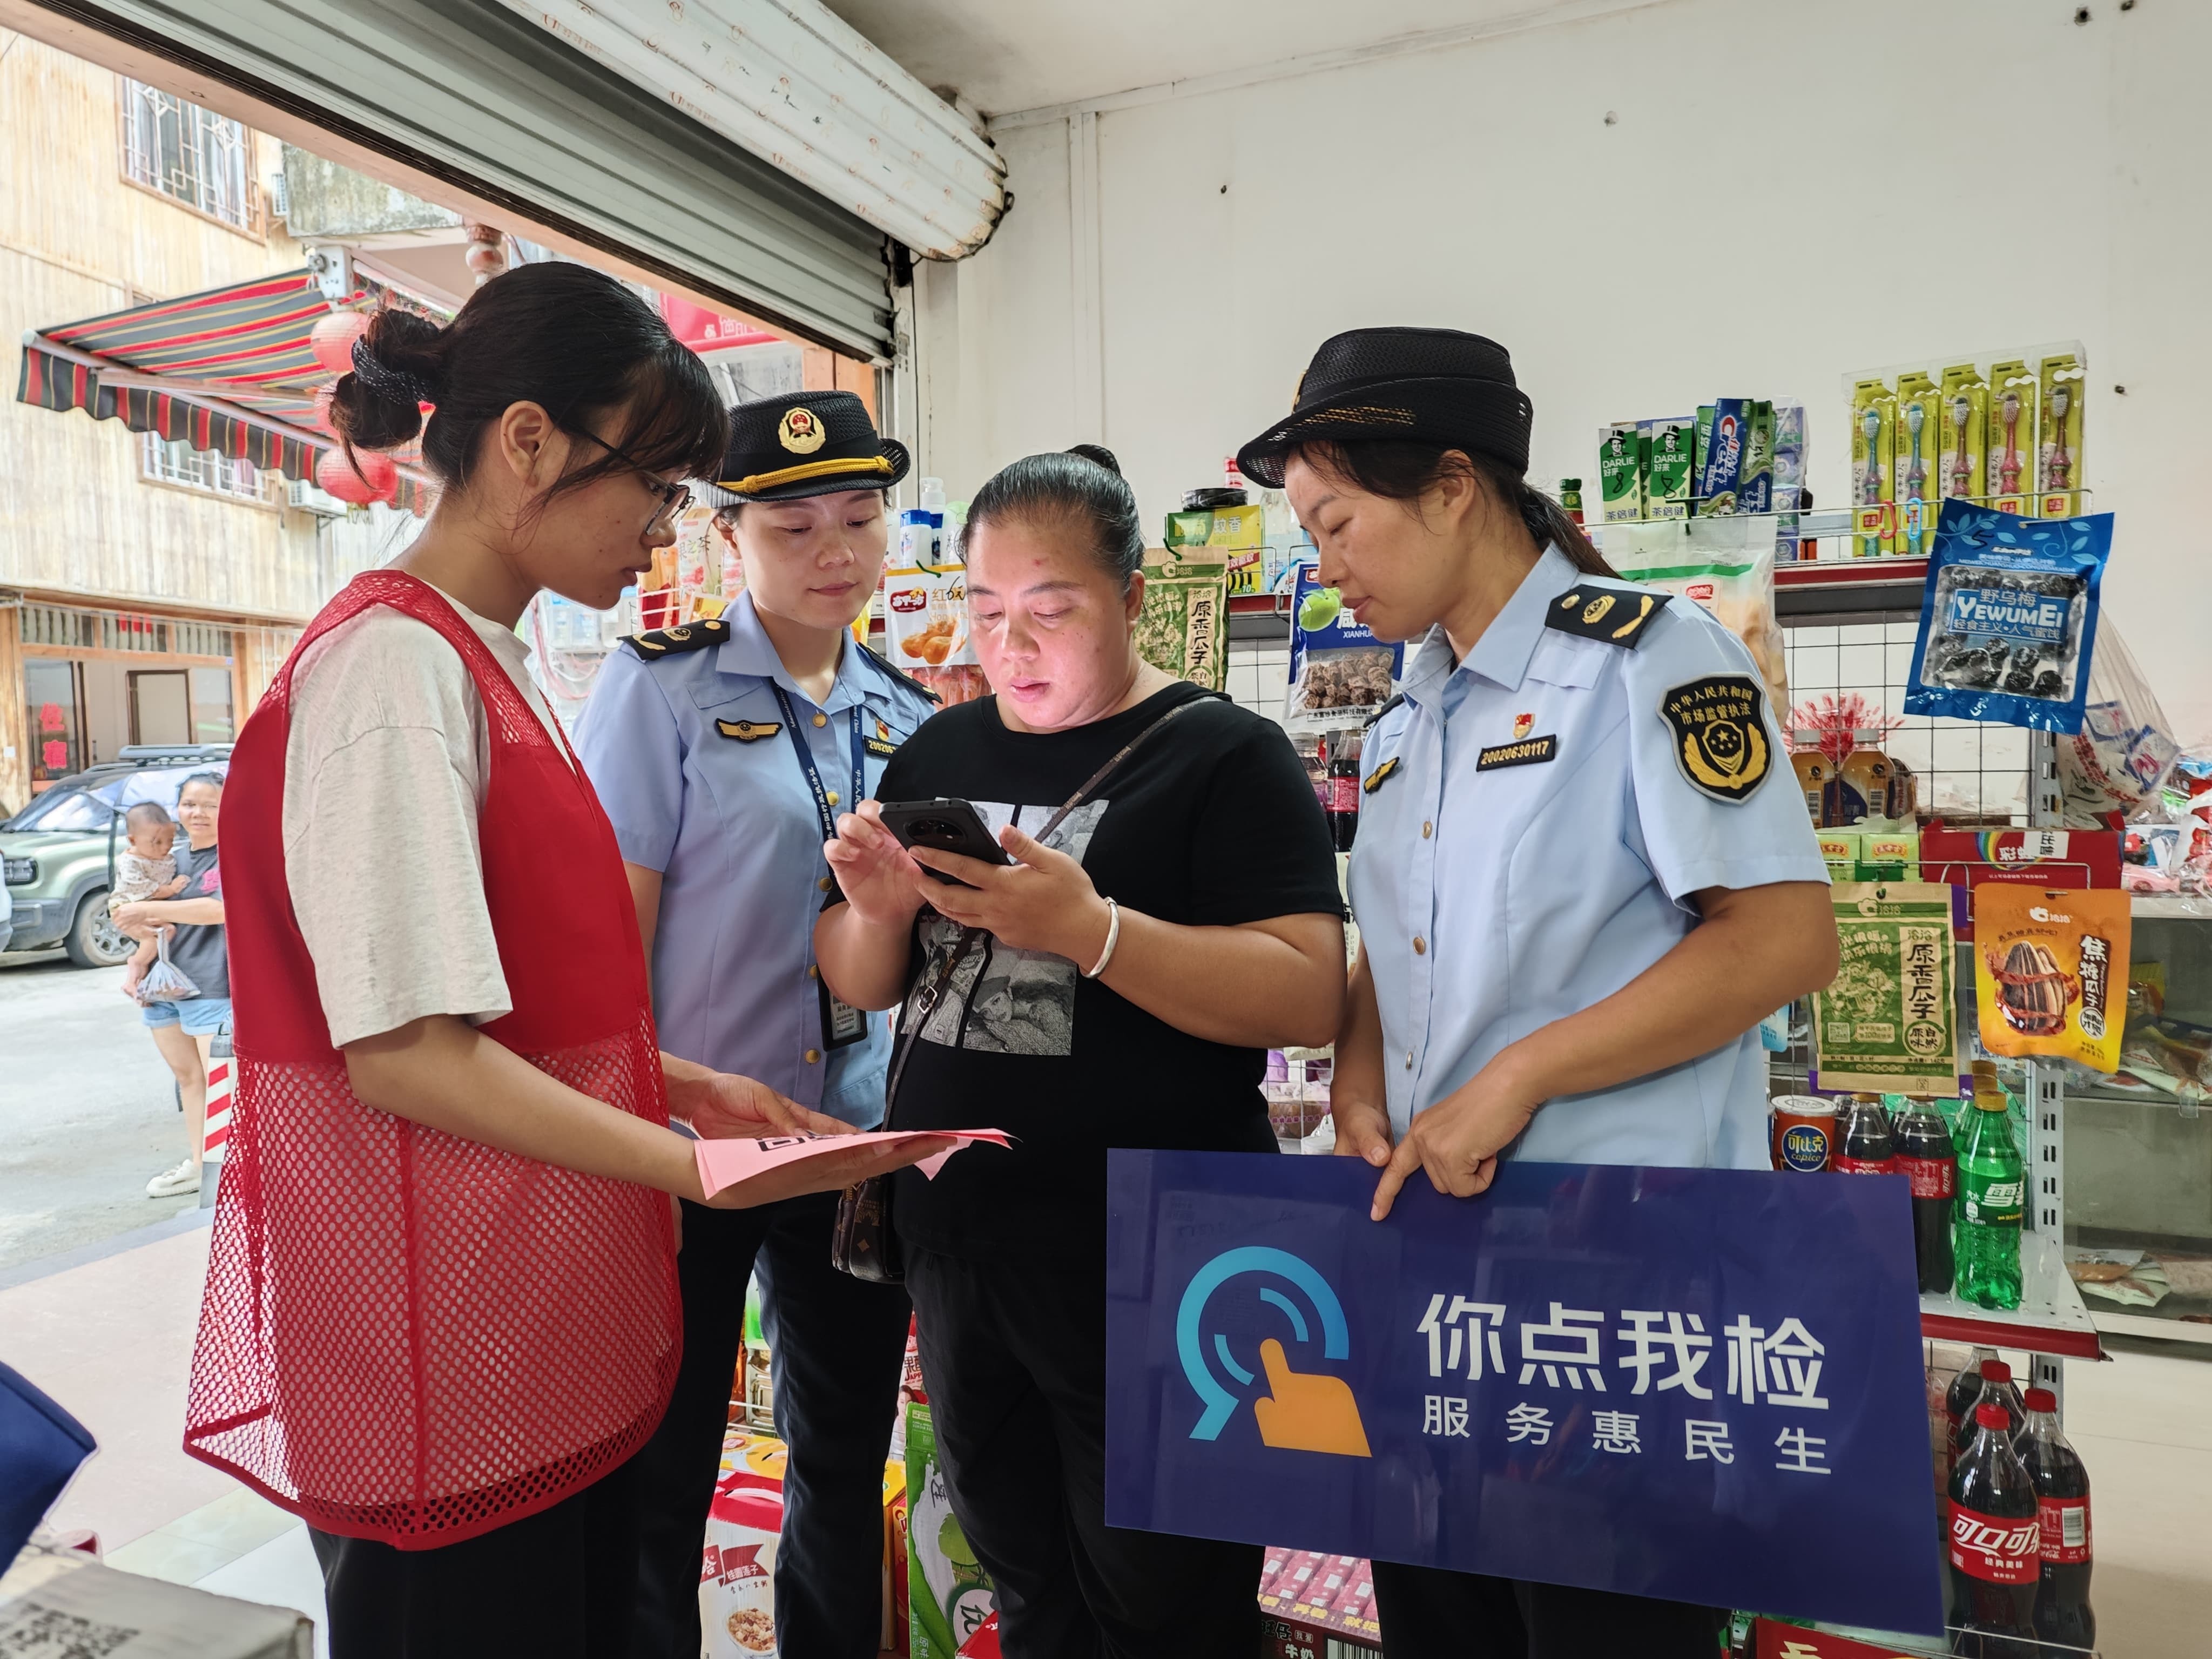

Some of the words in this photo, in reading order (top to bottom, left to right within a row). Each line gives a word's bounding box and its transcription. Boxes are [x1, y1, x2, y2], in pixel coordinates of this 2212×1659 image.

[1654, 453, 1687, 464] DARLIE
[1715, 415, 1737, 485] Crest
[1602, 456, 1635, 468] DARLIE
[1603, 467, 1620, 477] 好来
[1654, 463, 1670, 472] 好来
[1613, 472, 1624, 494] 8
[1661, 474, 1676, 498] 8
[1606, 508, 1638, 521] 茶倍健
[1652, 505, 1684, 517] 茶倍健
[1213, 516, 1242, 534] 蚊香
[1242, 585, 1251, 594] 10
[1980, 589, 2037, 608] 野乌梅
[1191, 601, 1211, 664] 原香瓜子
[1670, 685, 1753, 713] 中华人民共和国
[1680, 702, 1752, 726] 市场监管执法
[1481, 740, 1549, 766] 20020630117
[2040, 831, 2059, 857] 出售
[1907, 929, 1933, 940] 洽洽
[2079, 935, 2108, 1007] 焦糖瓜子
[1906, 944, 1937, 1019] 原香瓜子
[1787, 1133, 1824, 1154] 可比克
[1791, 1152, 1822, 1163] copico
[1416, 1293, 1830, 1410] 你点我检
[910, 1372, 922, 1381] APP
[1421, 1394, 1831, 1475] 服务惠民生
[1285, 1643, 1314, 1659] 牛奶
